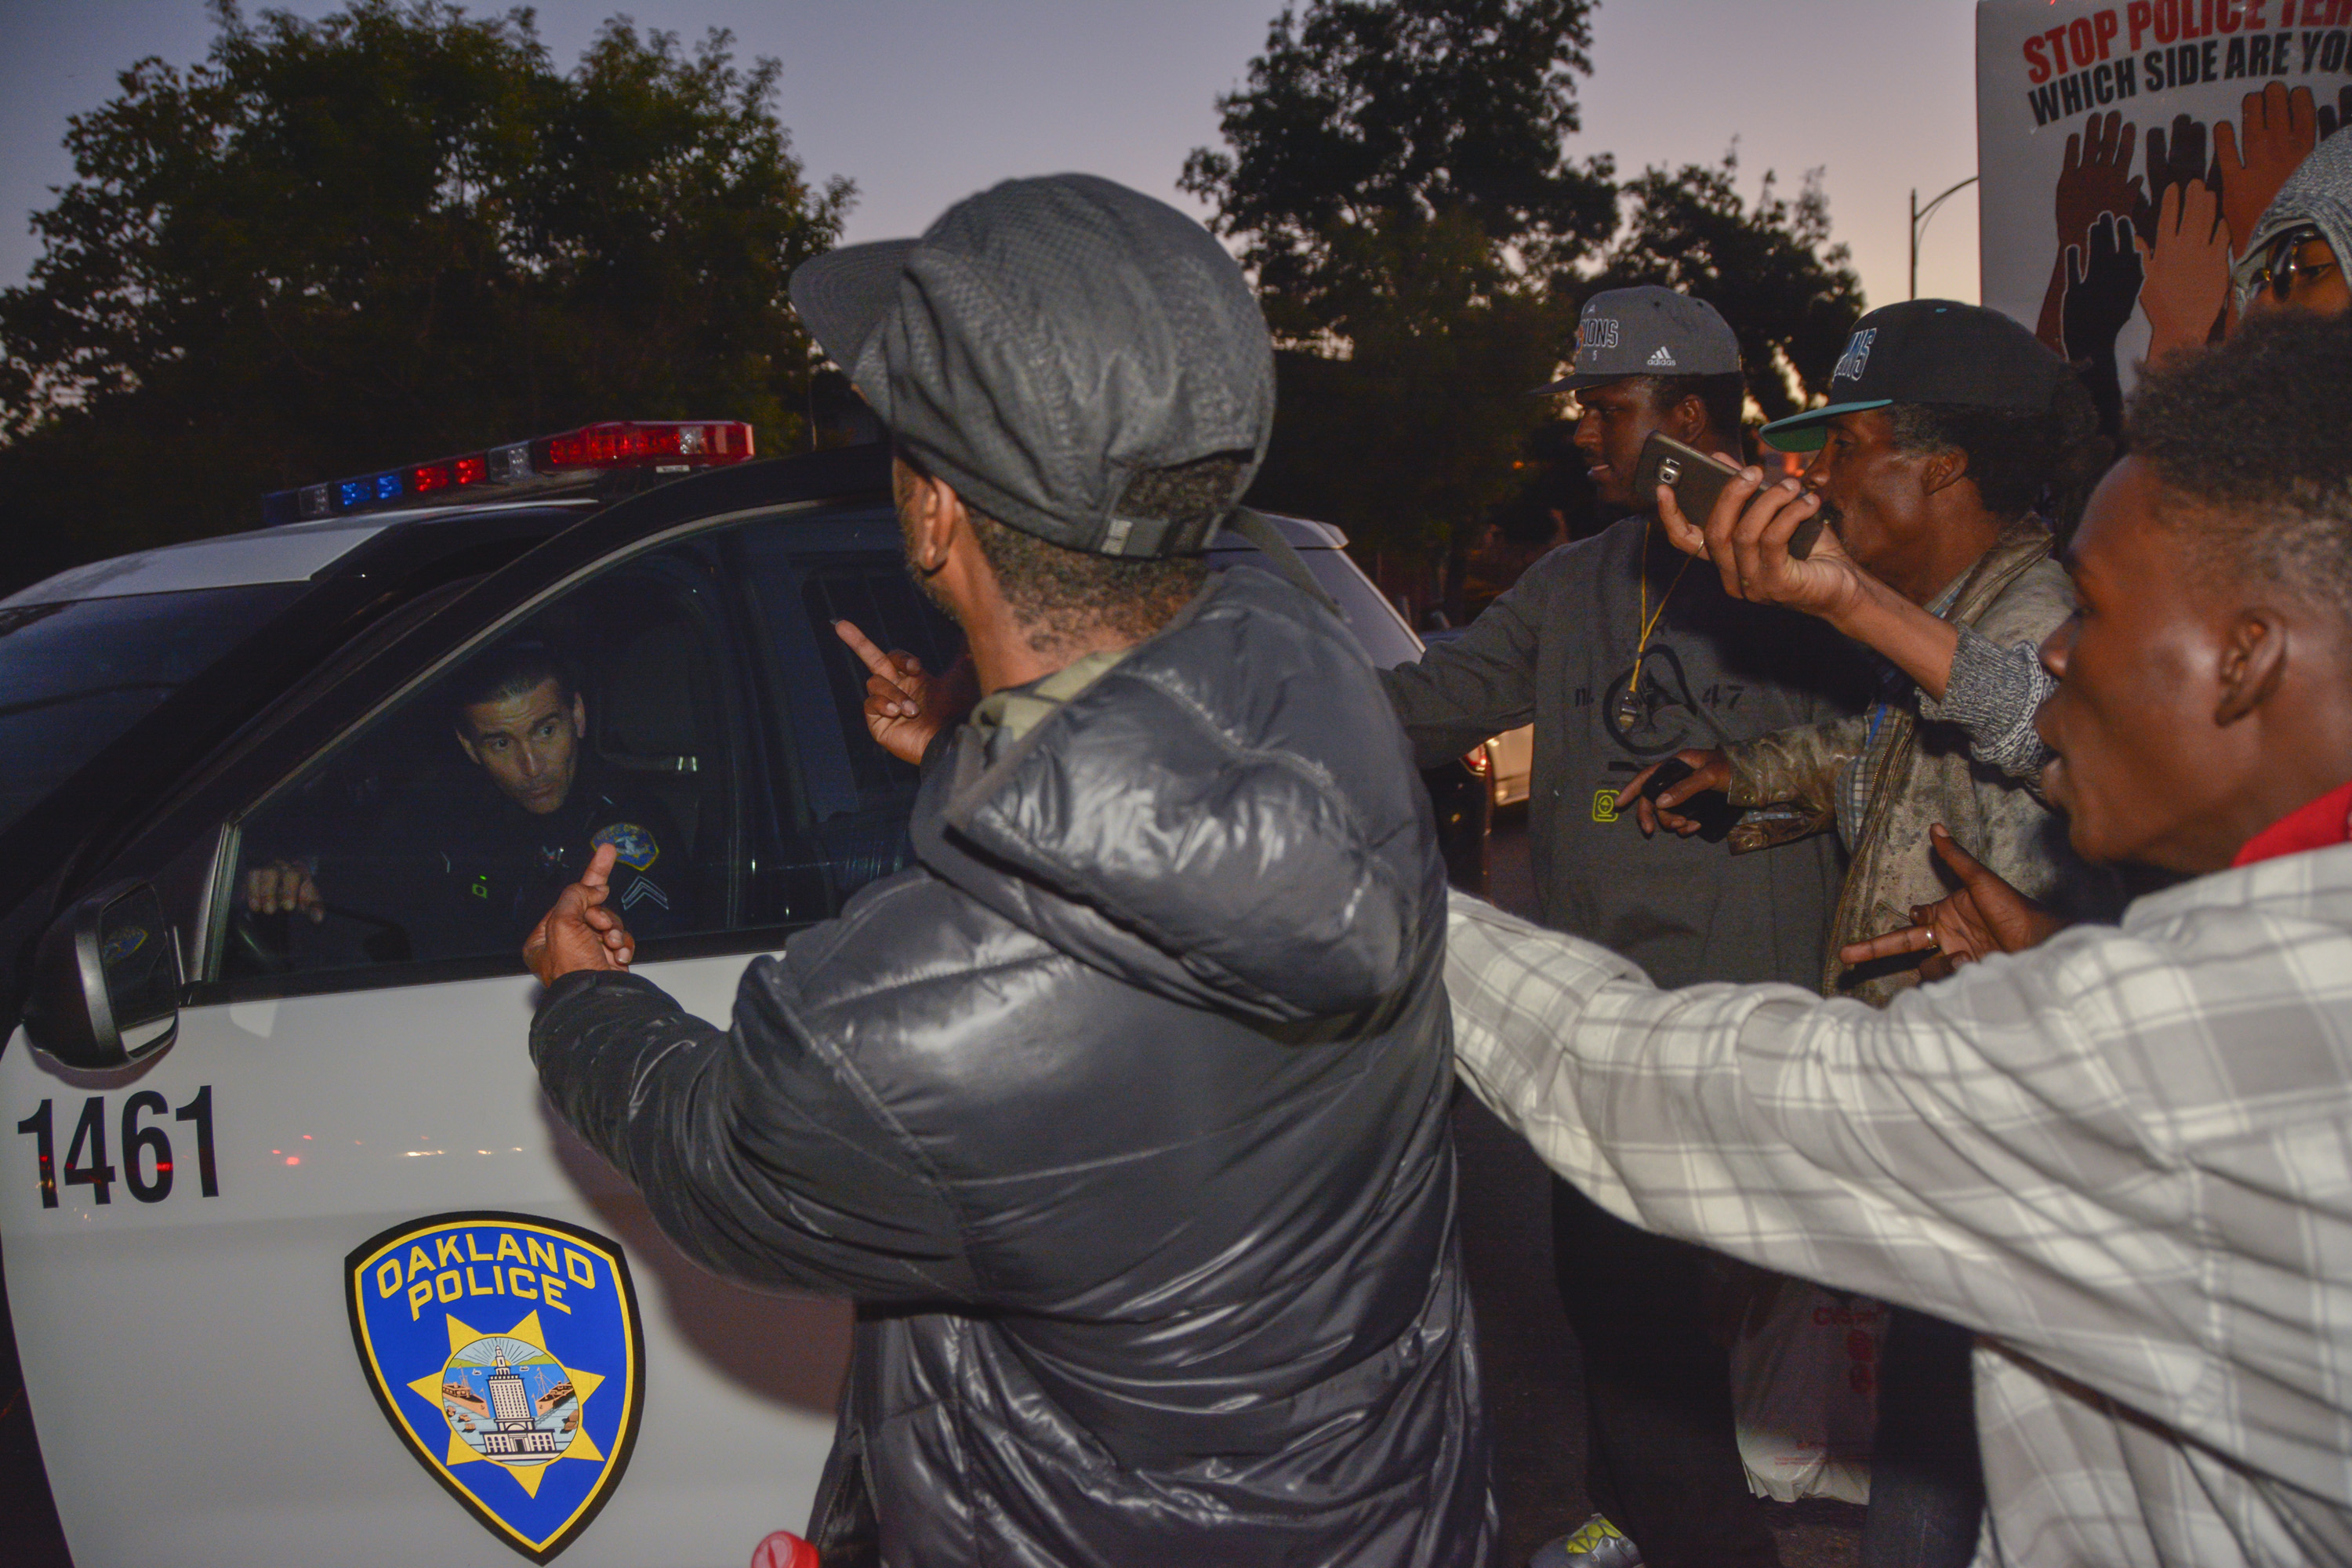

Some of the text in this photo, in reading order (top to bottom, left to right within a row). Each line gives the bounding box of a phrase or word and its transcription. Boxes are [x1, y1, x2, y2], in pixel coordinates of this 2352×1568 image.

[2023, 9, 2118, 84] STOP
[2128, 0, 2266, 51] POLICE
[2027, 56, 2136, 126] WHICH
[2144, 40, 2217, 92] SIDE
[2224, 32, 2292, 80] ARE
[17, 1085, 219, 1208] 1461
[376, 1233, 595, 1298] OAKLAND
[407, 1265, 572, 1322] POLICE
